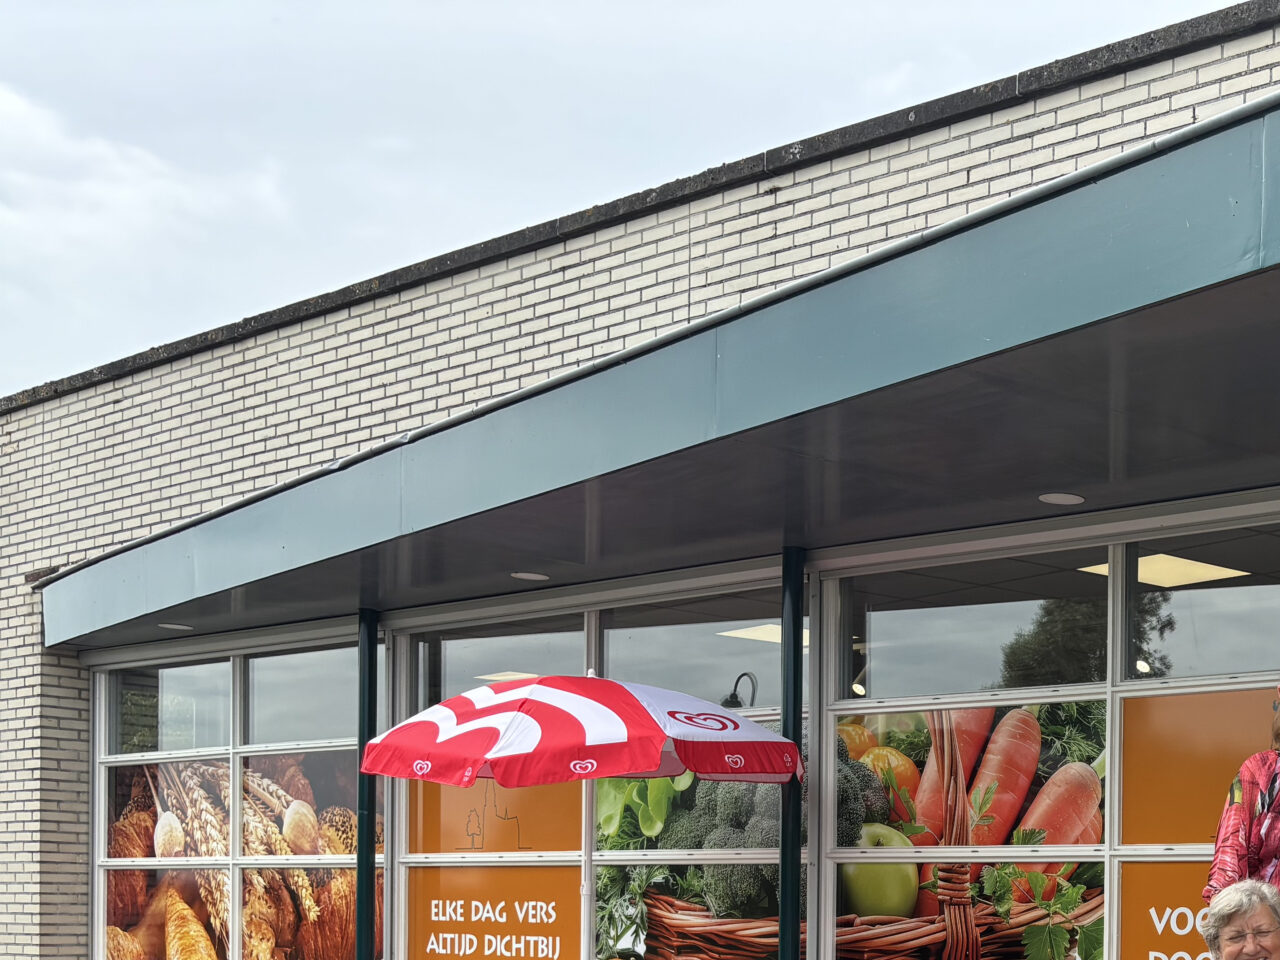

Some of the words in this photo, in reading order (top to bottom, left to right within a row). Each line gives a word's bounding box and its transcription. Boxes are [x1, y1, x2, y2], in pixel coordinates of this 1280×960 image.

[430, 900, 464, 922] ELKE
[471, 900, 507, 924] DAG
[514, 901, 556, 924] VERS
[426, 932, 478, 957] ALTIJD
[484, 934, 561, 960] DICHTBIJ
